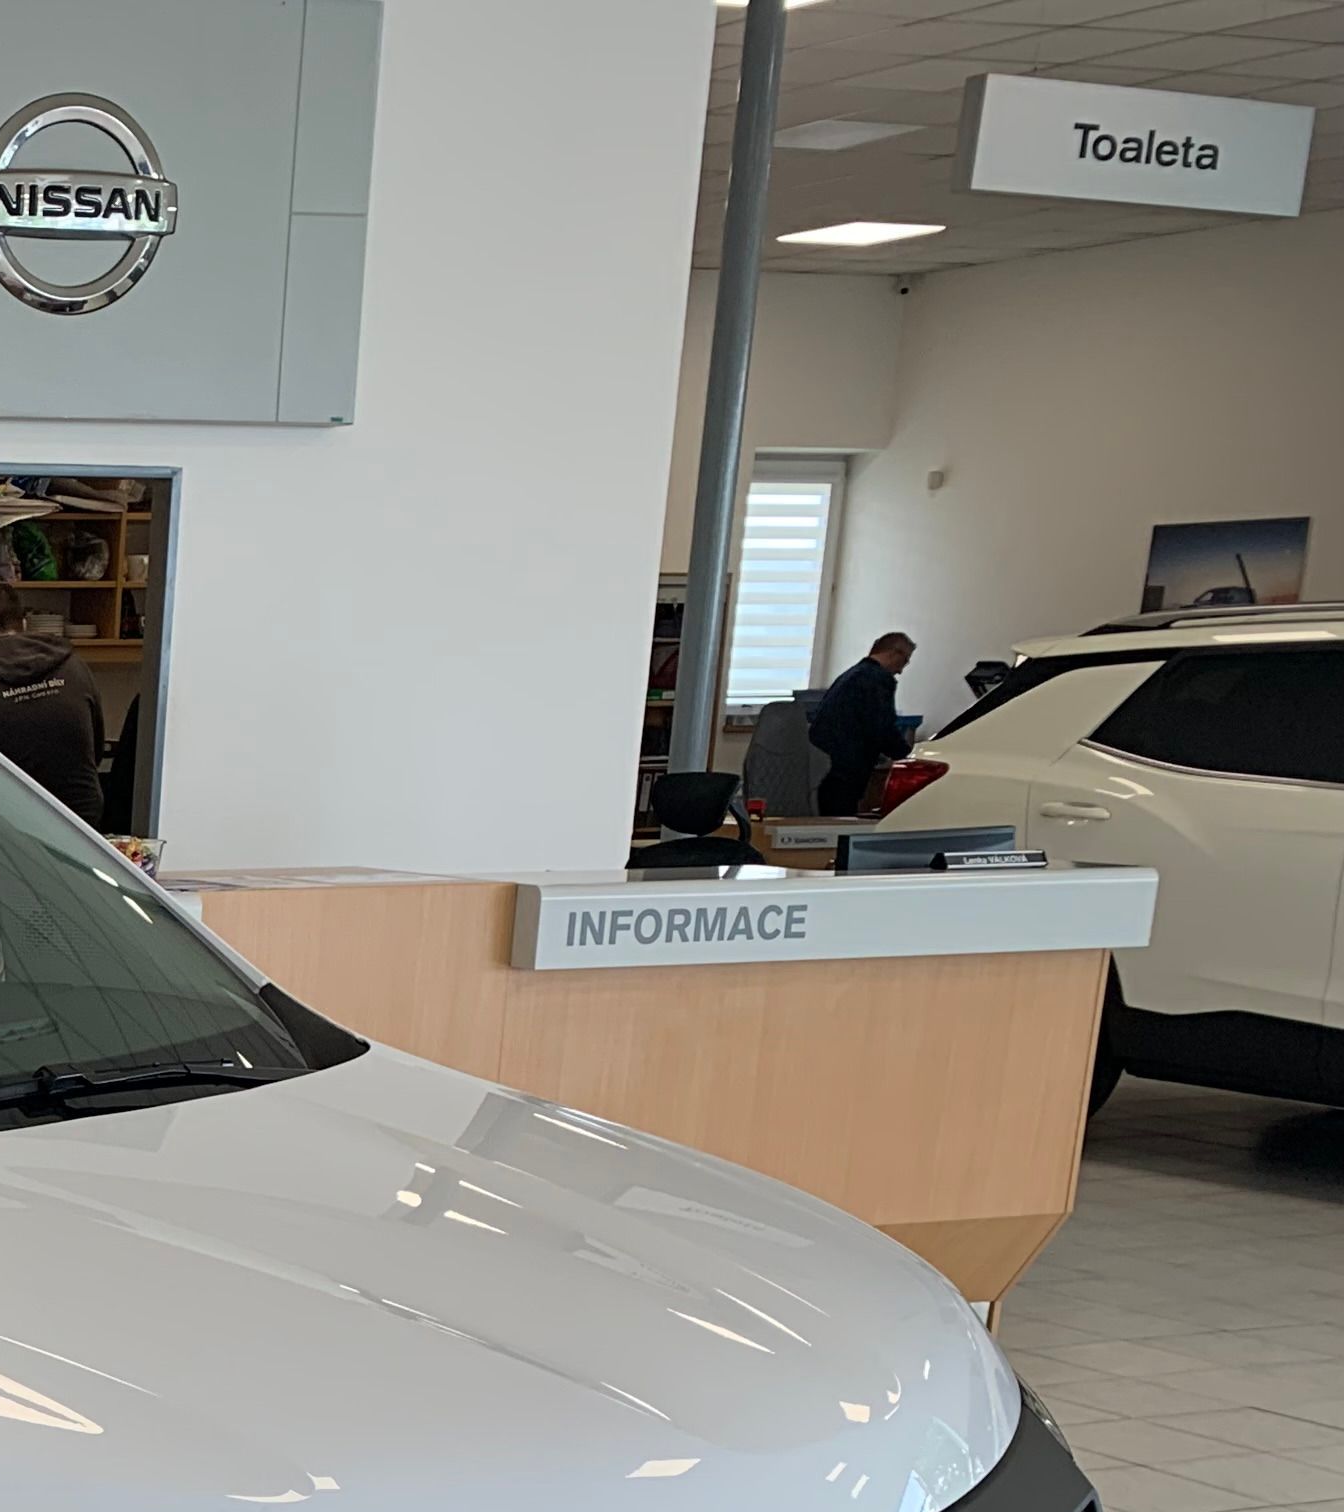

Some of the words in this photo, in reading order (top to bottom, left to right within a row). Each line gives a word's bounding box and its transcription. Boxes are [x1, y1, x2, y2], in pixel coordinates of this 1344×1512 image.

[1074, 122, 1219, 170] Toaleta
[2, 680, 47, 698] NÁHRADNÍ
[566, 904, 808, 947] INFORMACE
